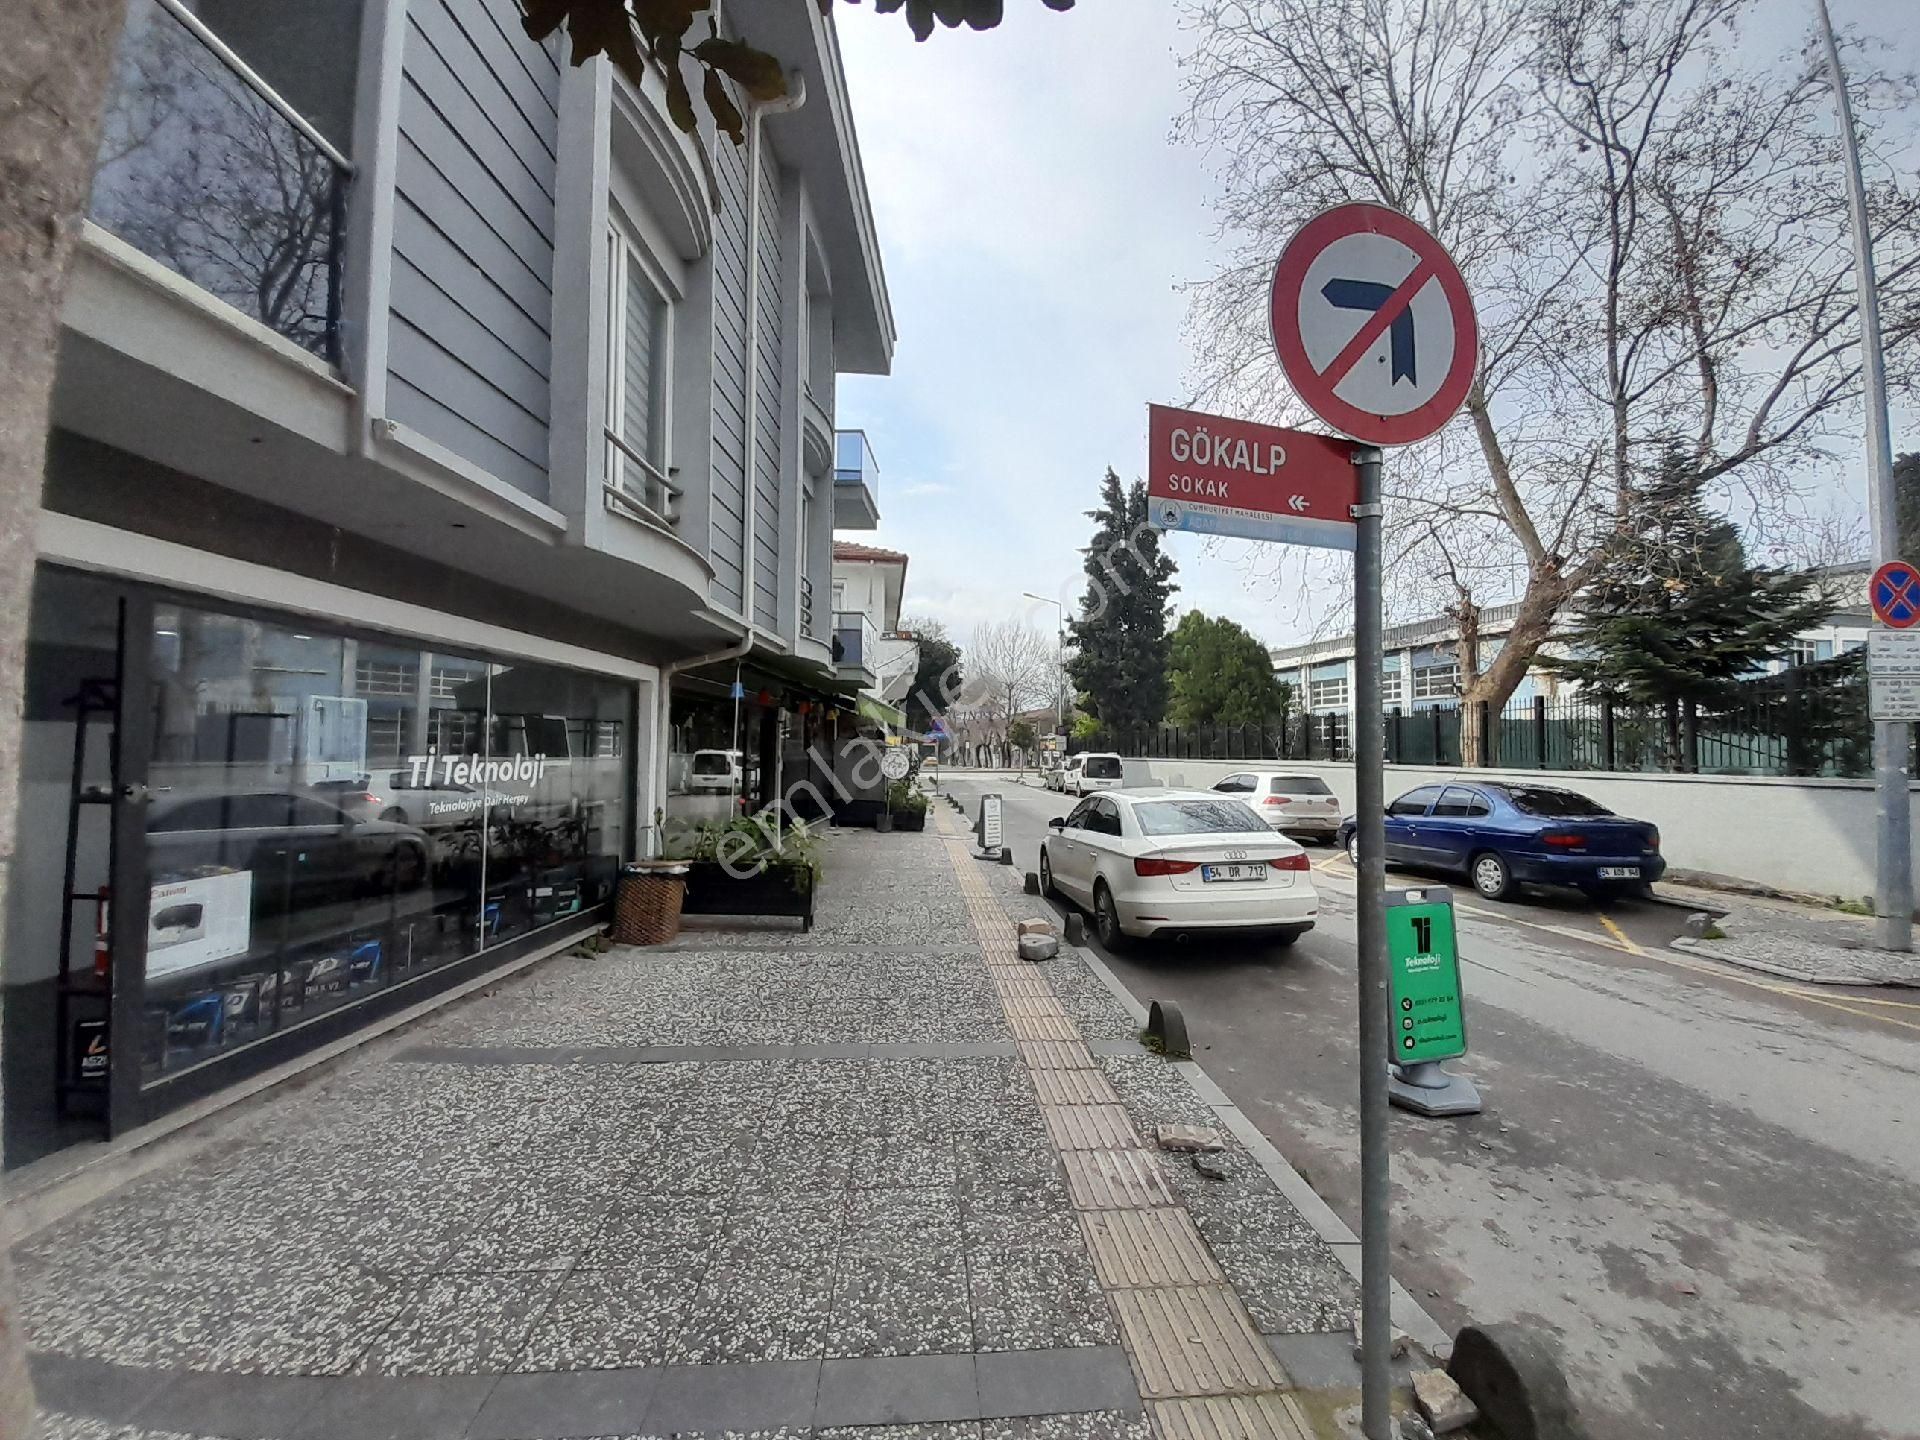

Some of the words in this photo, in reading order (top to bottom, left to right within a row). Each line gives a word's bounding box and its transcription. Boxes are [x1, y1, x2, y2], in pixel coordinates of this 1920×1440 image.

[1170, 426, 1287, 475] GÖKALP
[1168, 473, 1229, 498] SOKAK
[441, 752, 546, 788] Teknoloji
[1209, 867, 1221, 878] 54
[1247, 865, 1264, 876] 712
